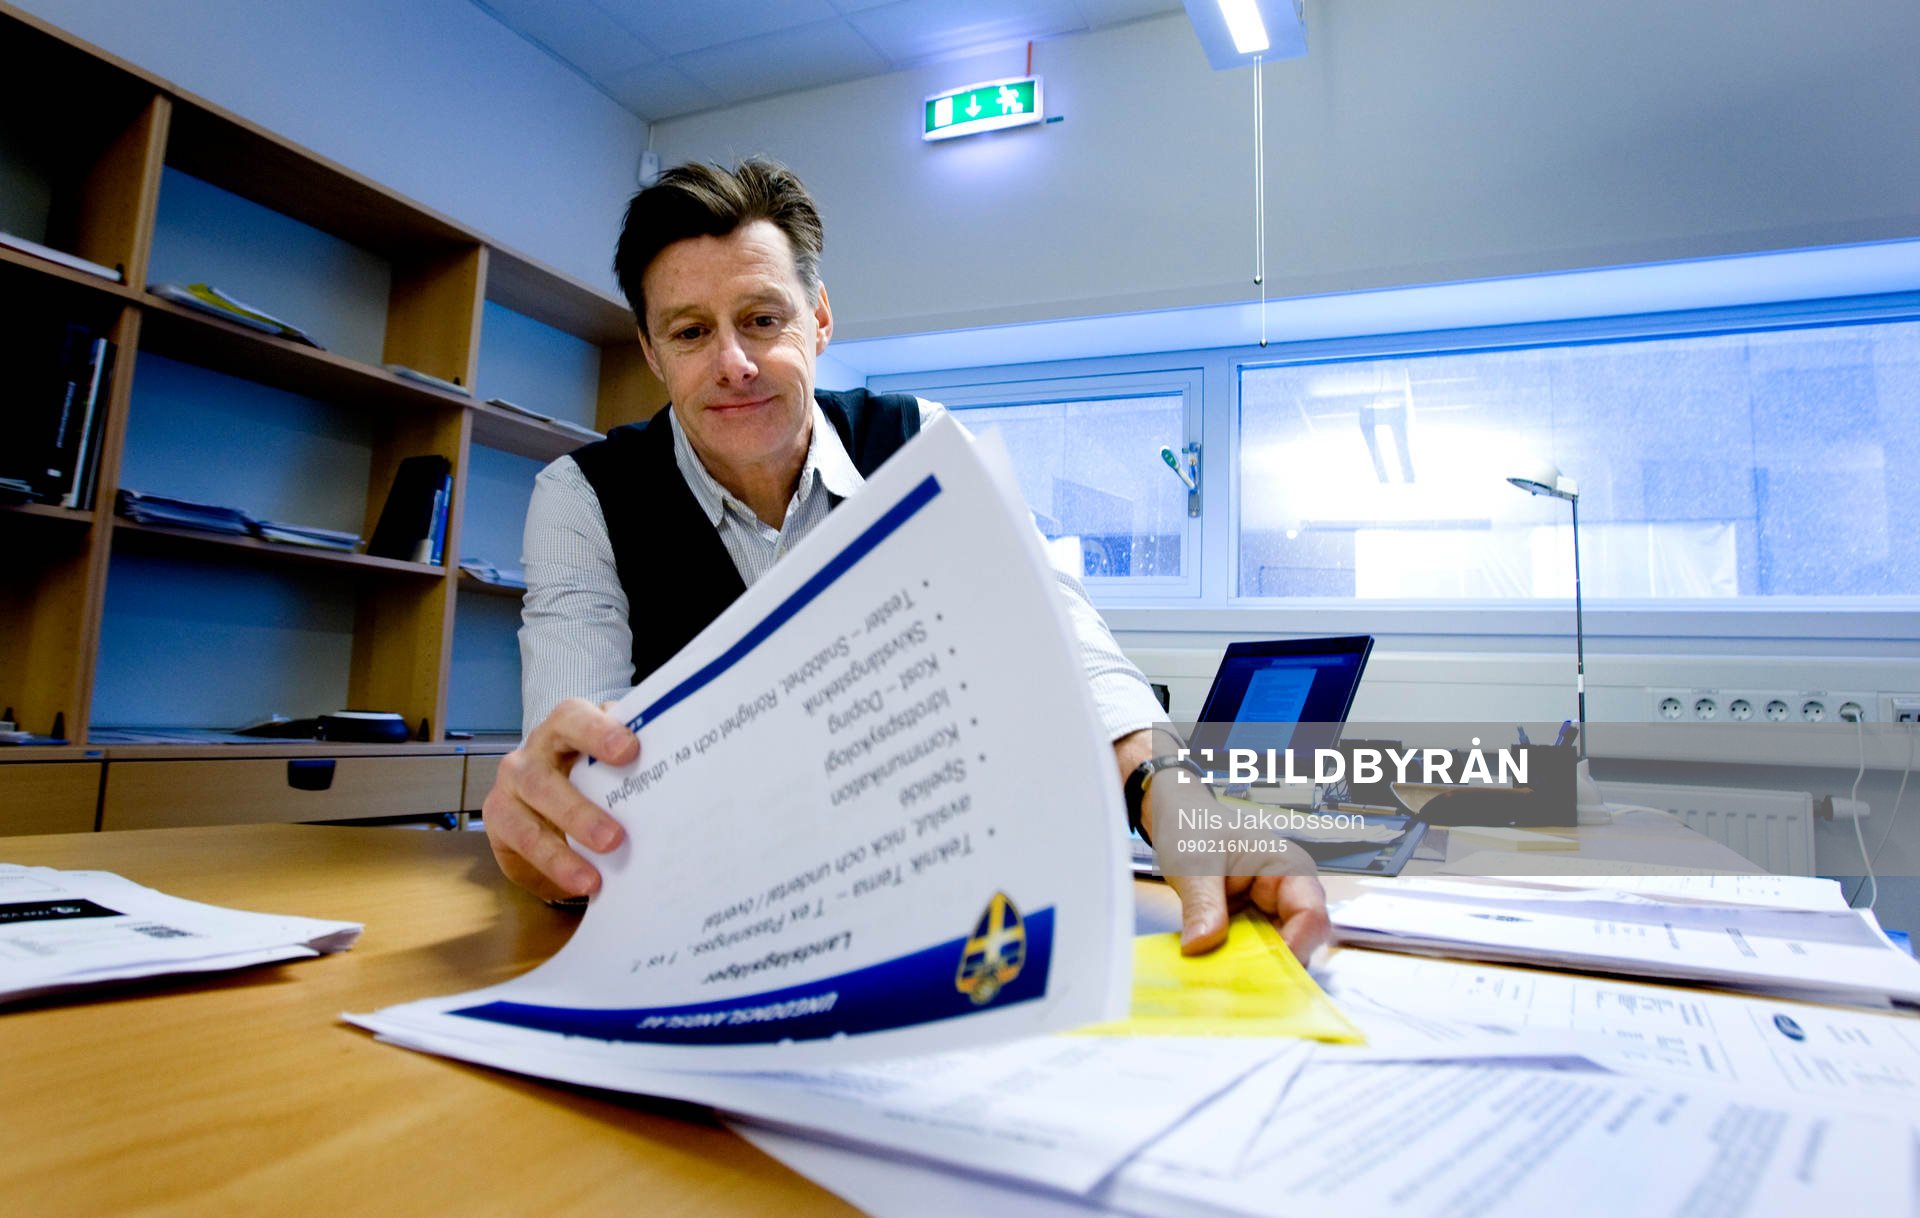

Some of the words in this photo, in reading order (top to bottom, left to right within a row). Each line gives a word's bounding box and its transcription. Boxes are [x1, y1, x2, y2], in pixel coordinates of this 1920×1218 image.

[864, 588, 916, 632] Tester
[802, 620, 927, 716] Skivstångsteknik
[900, 653, 940, 691] Kost
[720, 694, 778, 739] Rörlighet
[824, 687, 951, 778] Idrottspsykologi
[827, 689, 884, 735] Doping
[672, 745, 691, 765] ev.
[696, 731, 720, 755] och
[606, 760, 669, 808] uthållighet
[830, 723, 960, 807] Kommunikation
[835, 845, 867, 874] och
[870, 827, 906, 858] nick
[909, 832, 974, 874] Teknik
[765, 861, 831, 908] undertal
[852, 864, 904, 897] Tema
[702, 898, 754, 934] övertal
[791, 906, 811, 923] ex
